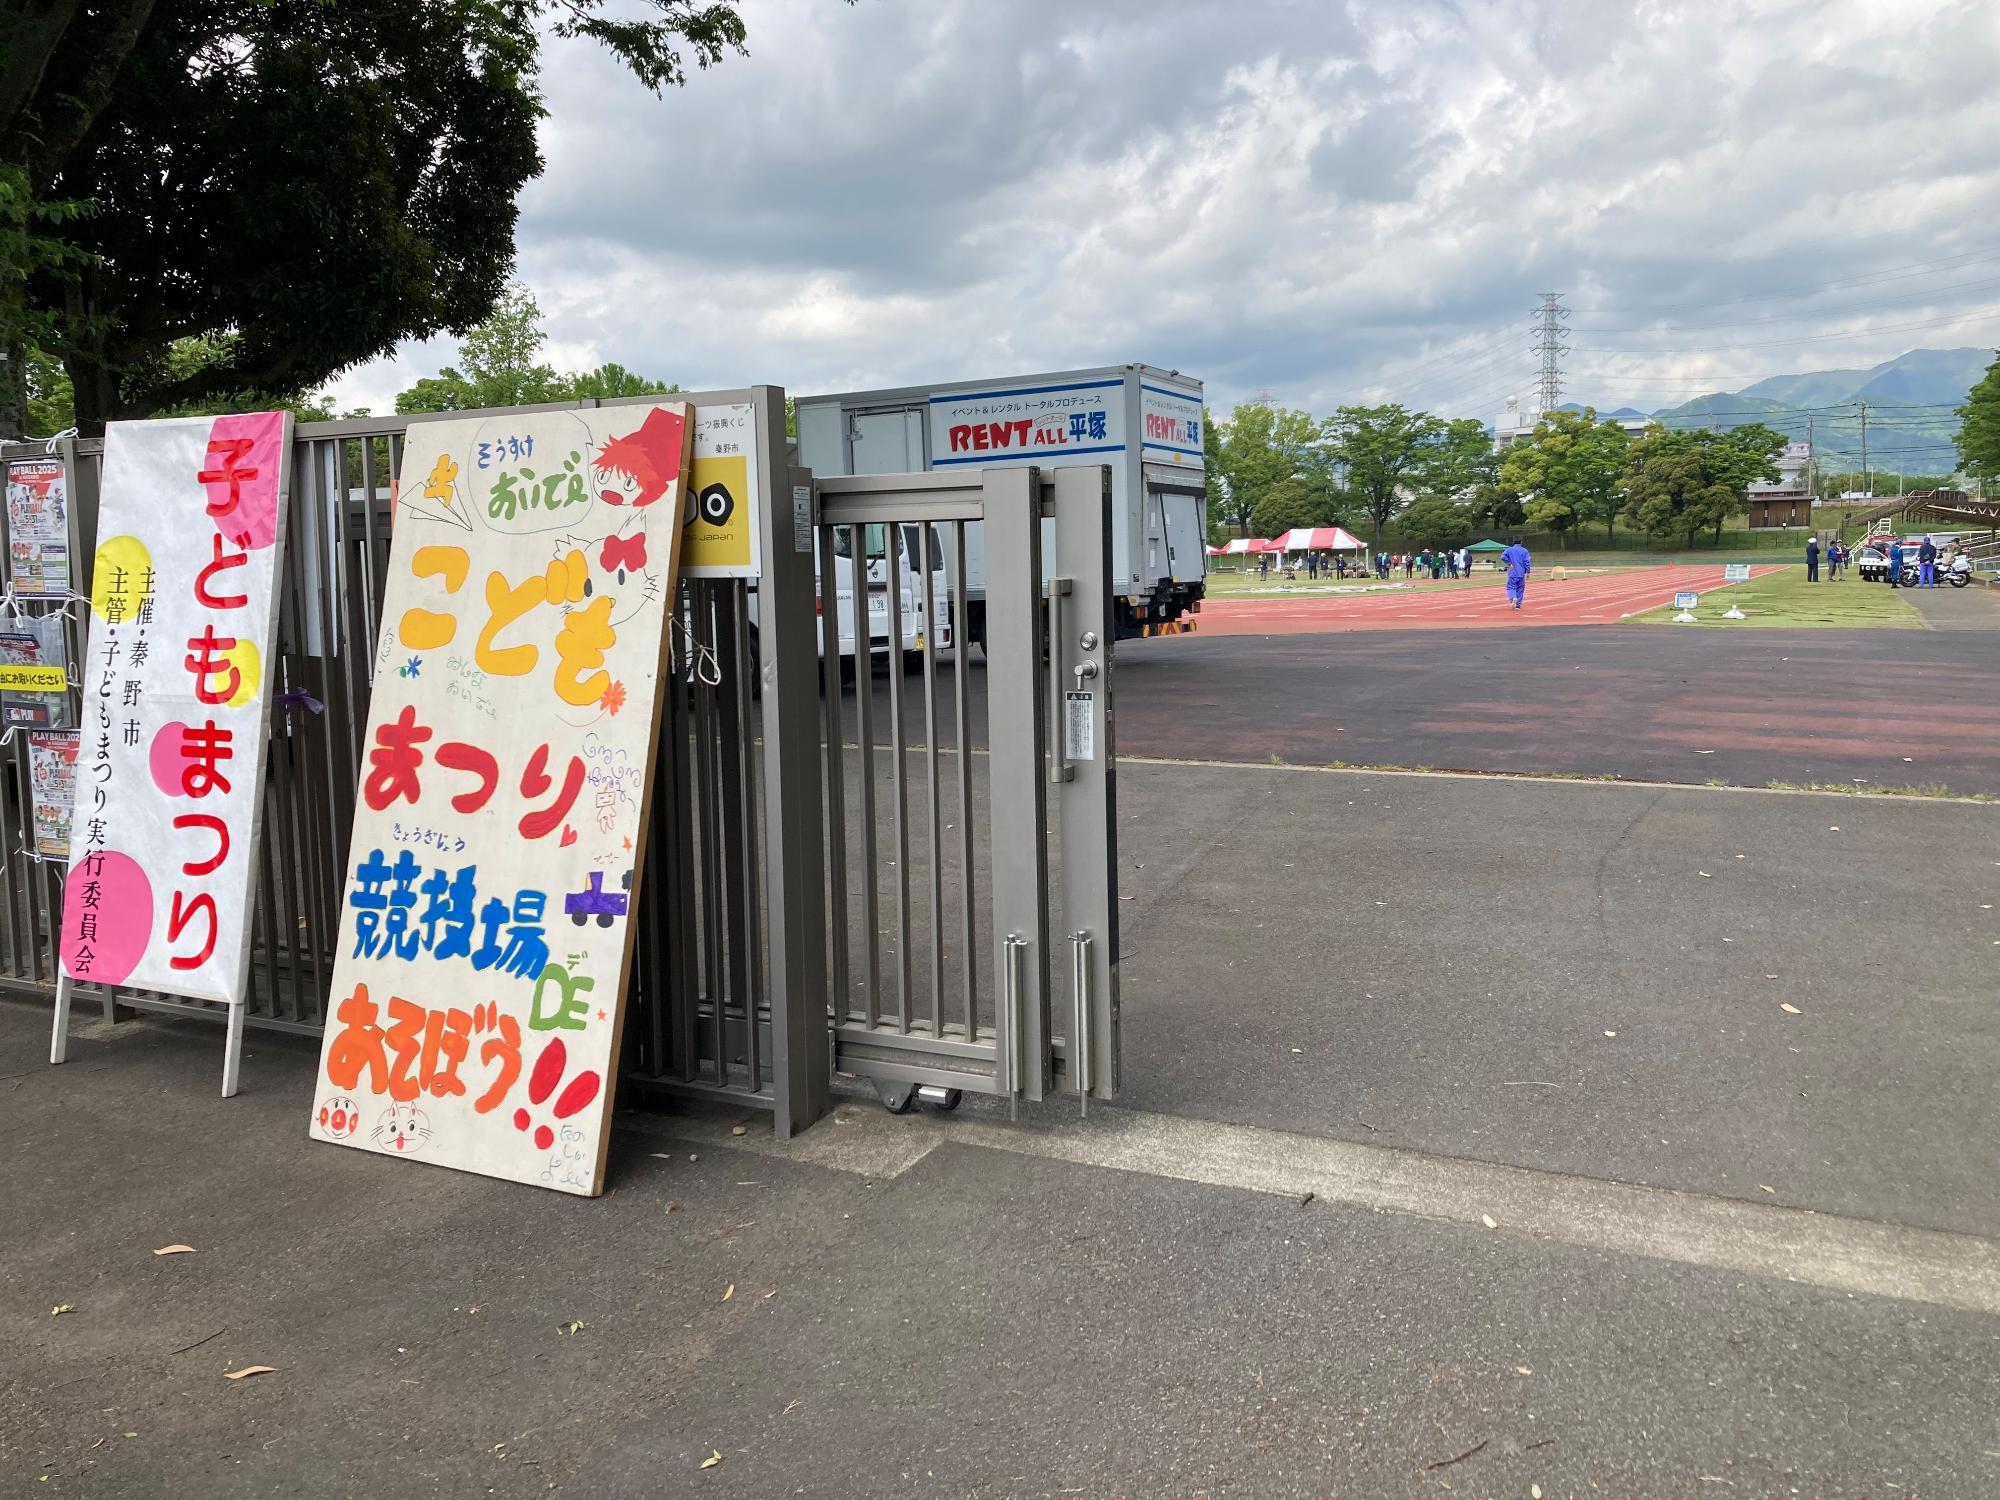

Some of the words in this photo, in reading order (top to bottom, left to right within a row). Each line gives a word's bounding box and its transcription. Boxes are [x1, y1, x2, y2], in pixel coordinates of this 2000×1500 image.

[694, 417, 745, 430] ーツ振興くじ
[949, 418, 1033, 452] RENT
[1034, 428, 1068, 445] ALL
[1069, 411, 1107, 442] 平塚
[1146, 413, 1176, 441] RENT
[1176, 428, 1187, 444] ALL
[1187, 421, 1199, 445] 平塚
[715, 443, 739, 454] 秦野市
[38, 464, 57, 475] 2025
[488, 450, 589, 521] おいでよ
[399, 546, 616, 706] こども
[168, 438, 259, 972] 子どもまつり
[67, 733, 80, 742] 202
[364, 704, 587, 841] まつり
[392, 822, 466, 853] きょうぎじょう
[349, 848, 550, 981] 競技場
[528, 962, 595, 1032] DE
